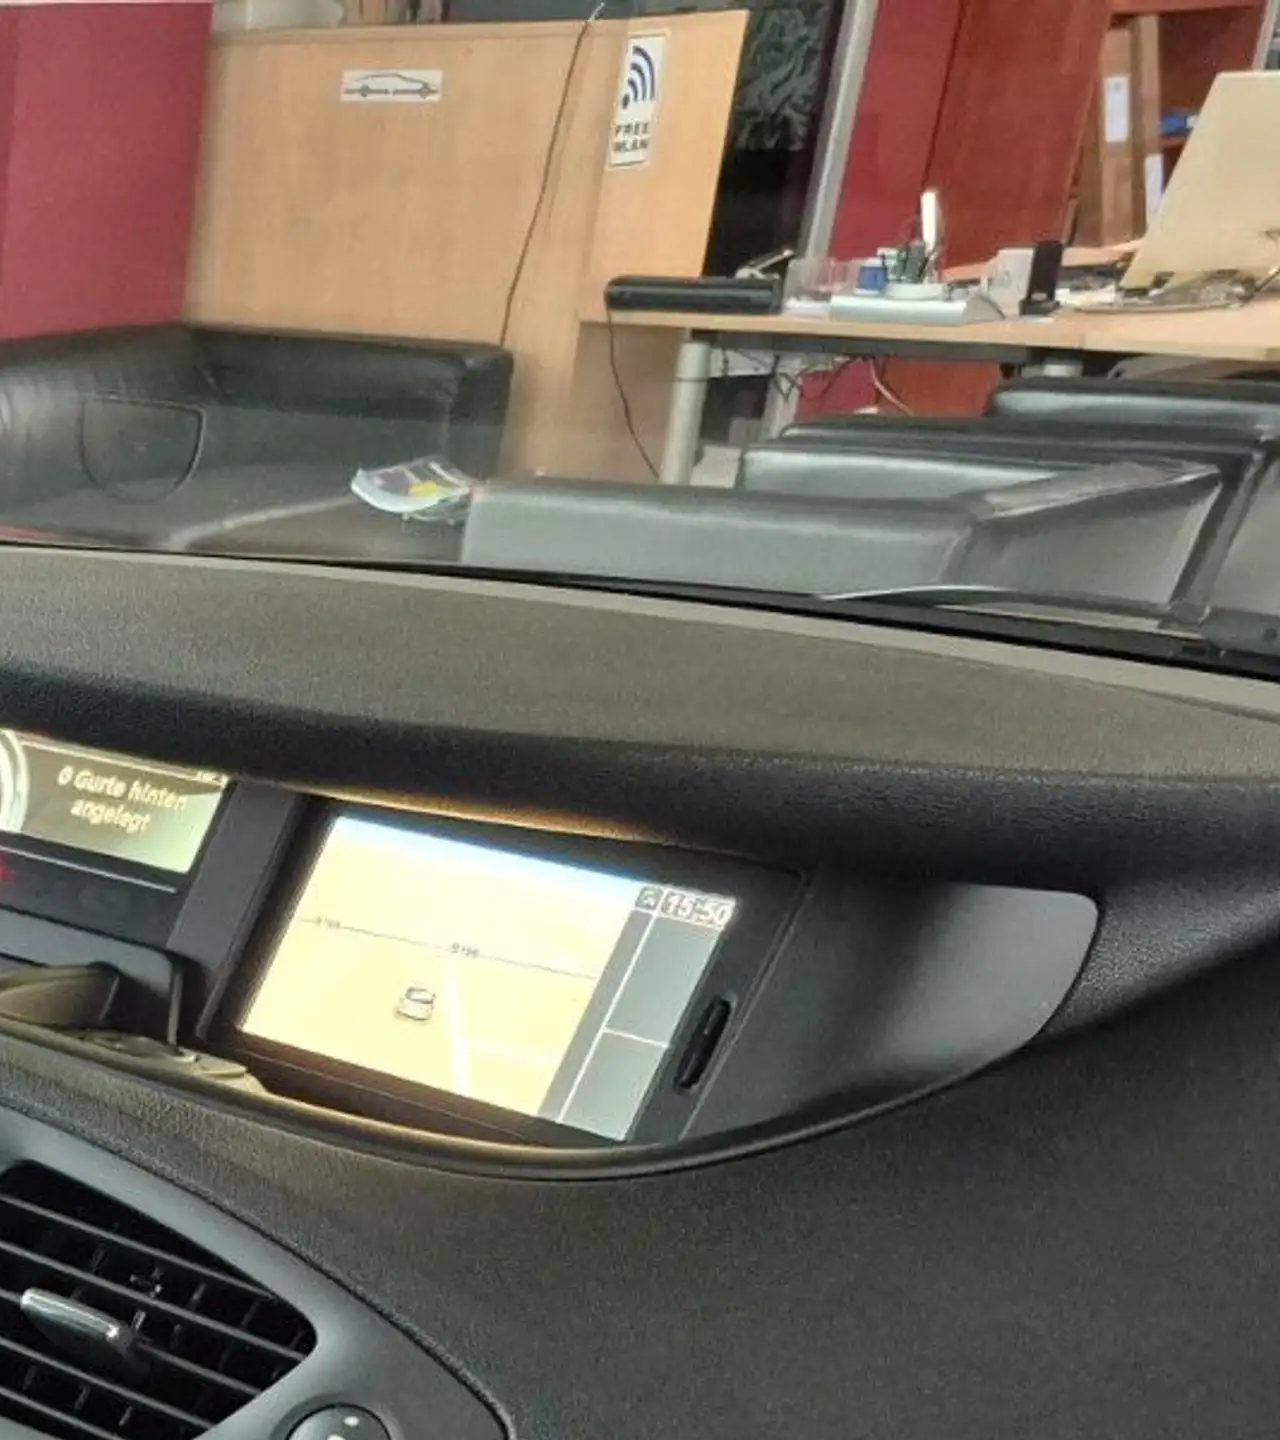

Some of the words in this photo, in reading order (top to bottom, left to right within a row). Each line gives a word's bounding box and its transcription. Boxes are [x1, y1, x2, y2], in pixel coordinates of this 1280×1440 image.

[614, 121, 648, 136] FREE
[73, 769, 127, 798] Gurte
[128, 780, 188, 811] hinten
[70, 799, 151, 834] angelegt
